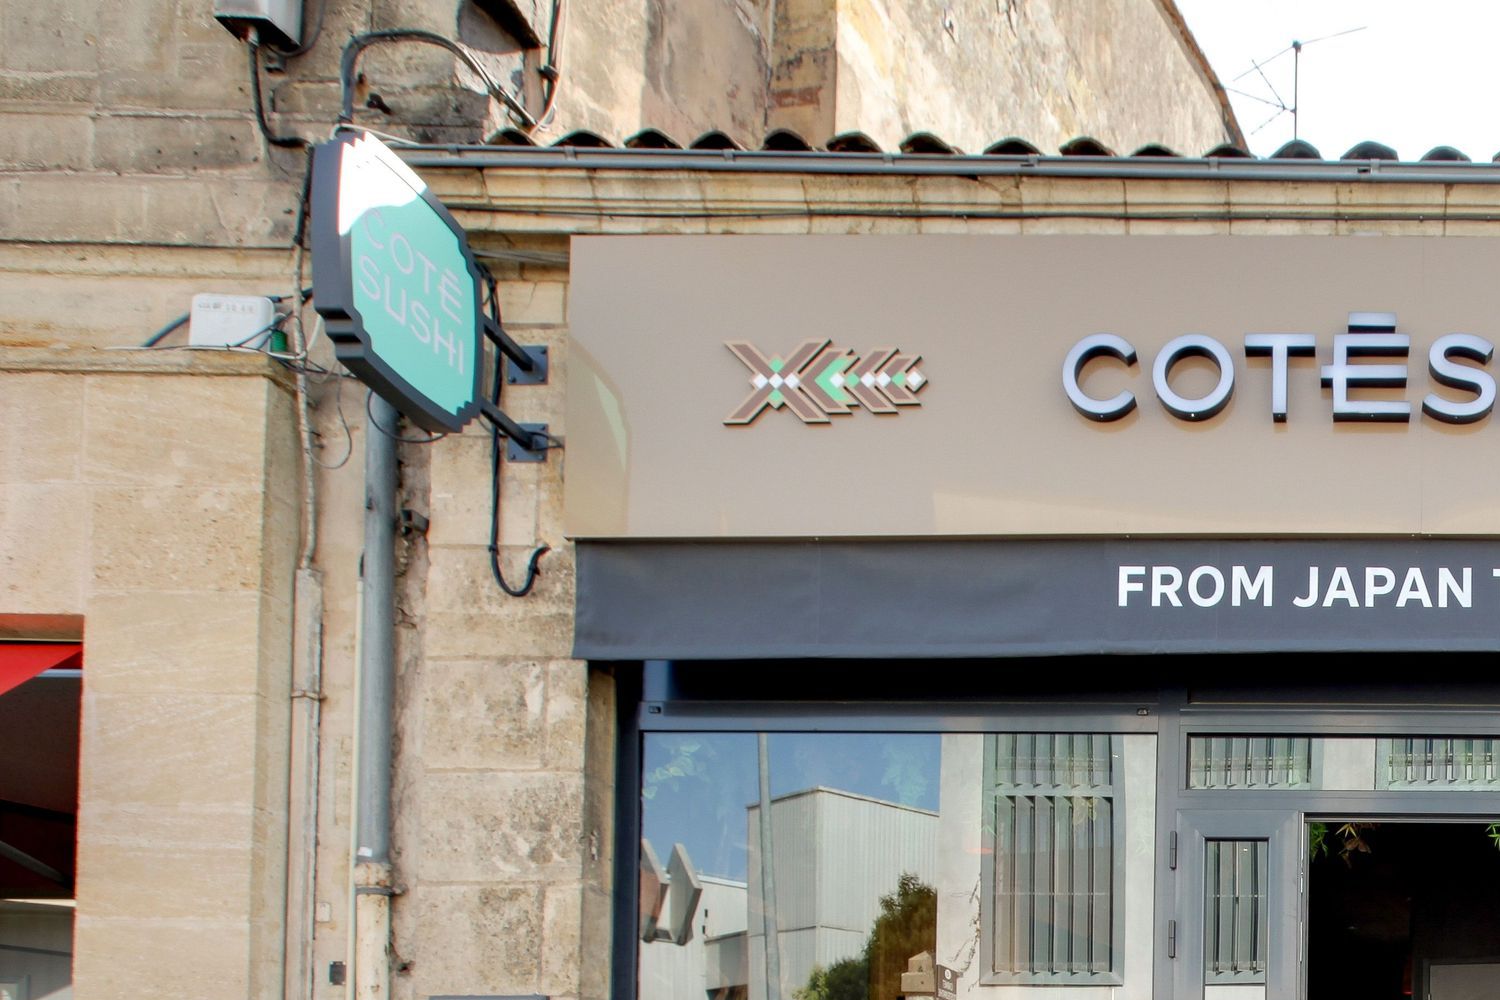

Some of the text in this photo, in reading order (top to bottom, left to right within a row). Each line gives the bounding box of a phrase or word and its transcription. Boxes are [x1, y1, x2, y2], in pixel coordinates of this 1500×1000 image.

[359, 255, 465, 375] SUSHI
[1117, 565, 1274, 608] FROM
[1292, 566, 1473, 609] JAPAN
